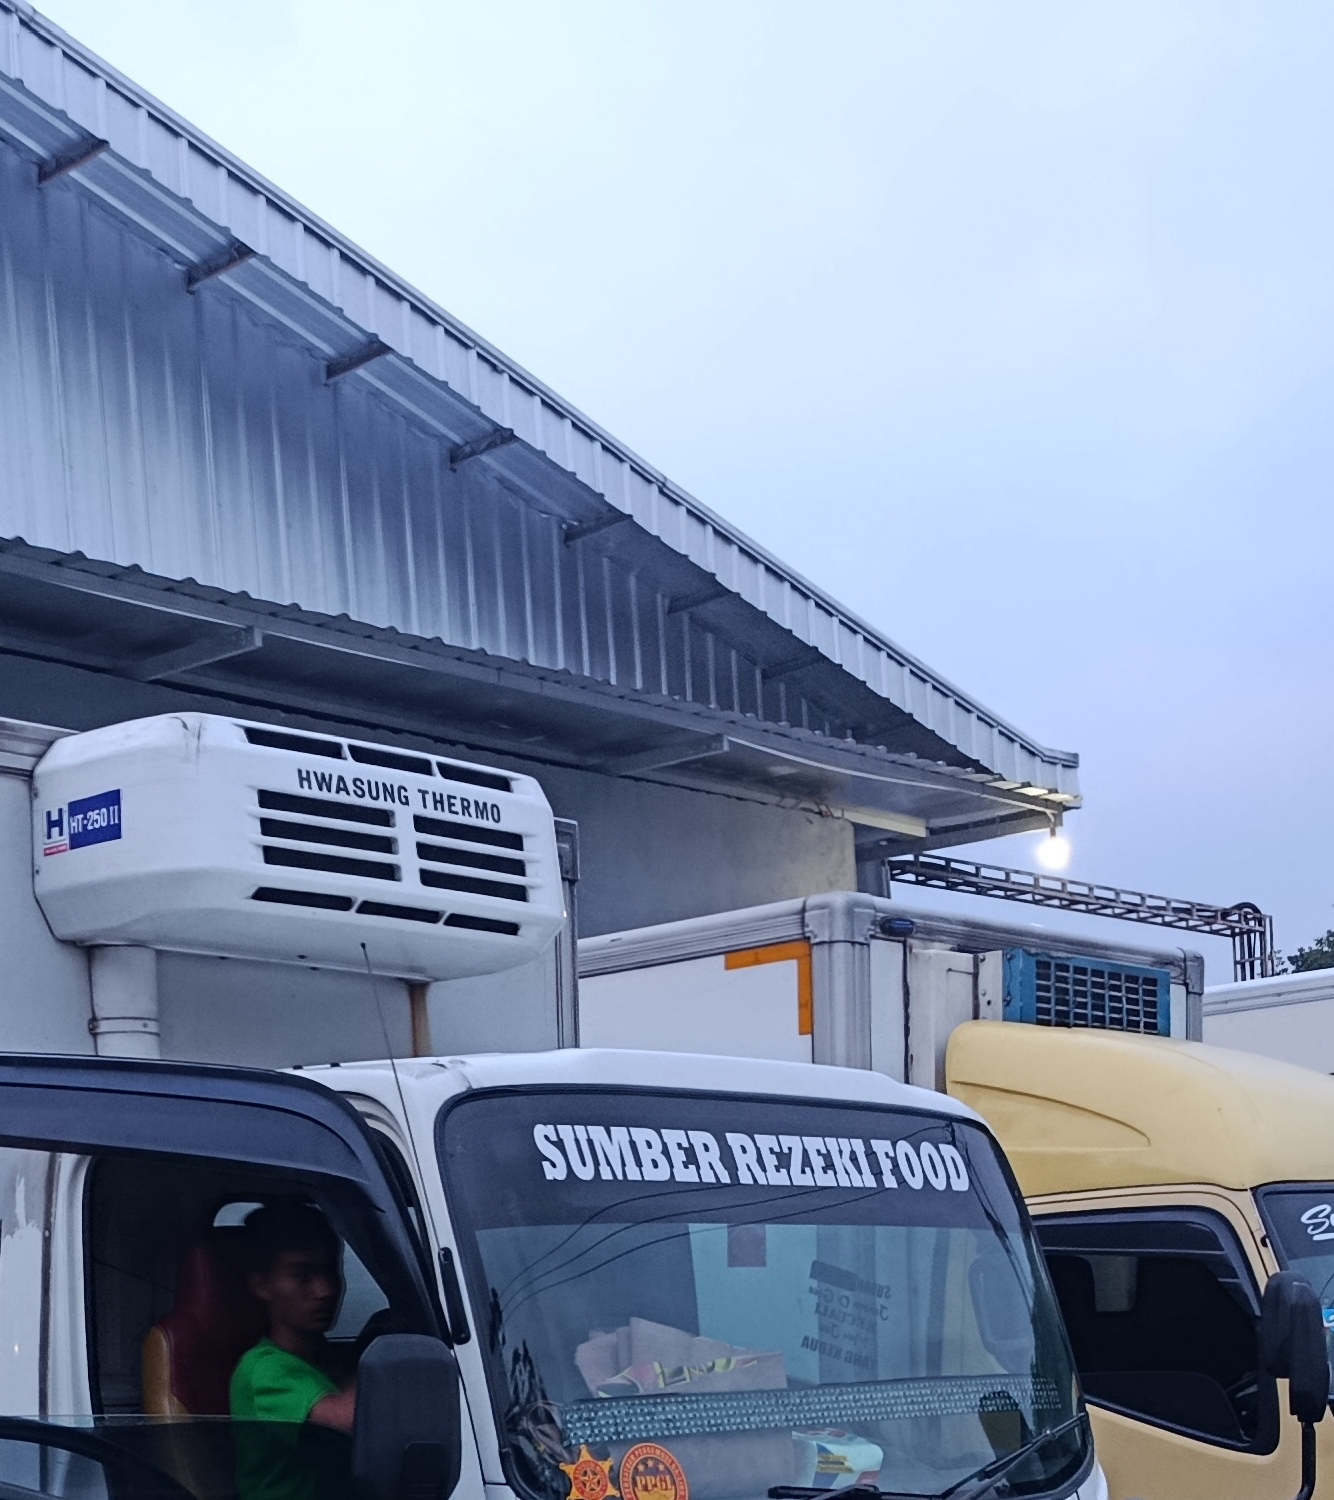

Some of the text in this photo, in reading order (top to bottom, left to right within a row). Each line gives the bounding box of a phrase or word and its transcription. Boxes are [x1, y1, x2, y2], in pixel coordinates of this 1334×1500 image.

[297, 768, 501, 824] HWASUNG THERMO
[533, 1123, 970, 1192] SUMBER REZEKI FOOD
